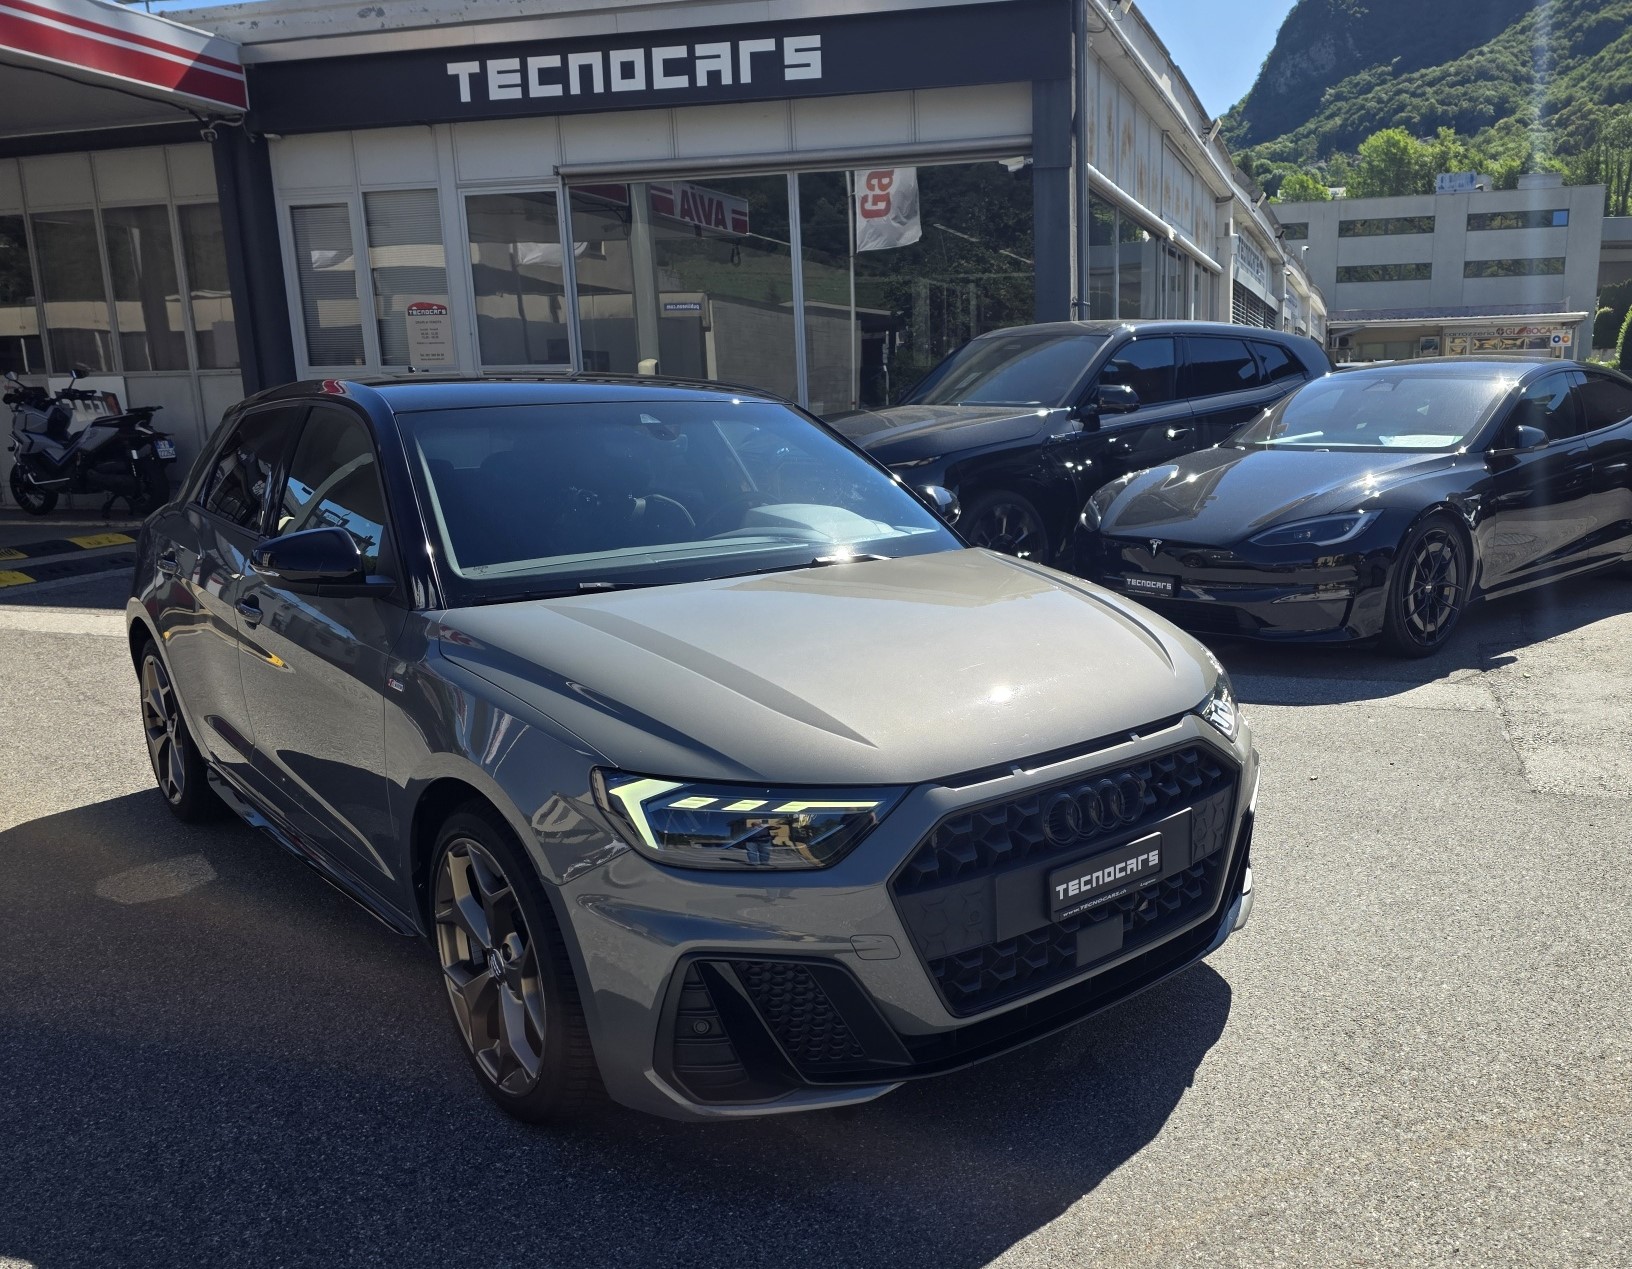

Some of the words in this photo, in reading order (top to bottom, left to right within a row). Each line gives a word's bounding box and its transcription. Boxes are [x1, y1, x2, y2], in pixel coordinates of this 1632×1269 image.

[447, 34, 822, 102] TECNOCARS
[1126, 578, 1172, 590] TECNOCARS
[1055, 849, 1159, 900] TECNOCARS
